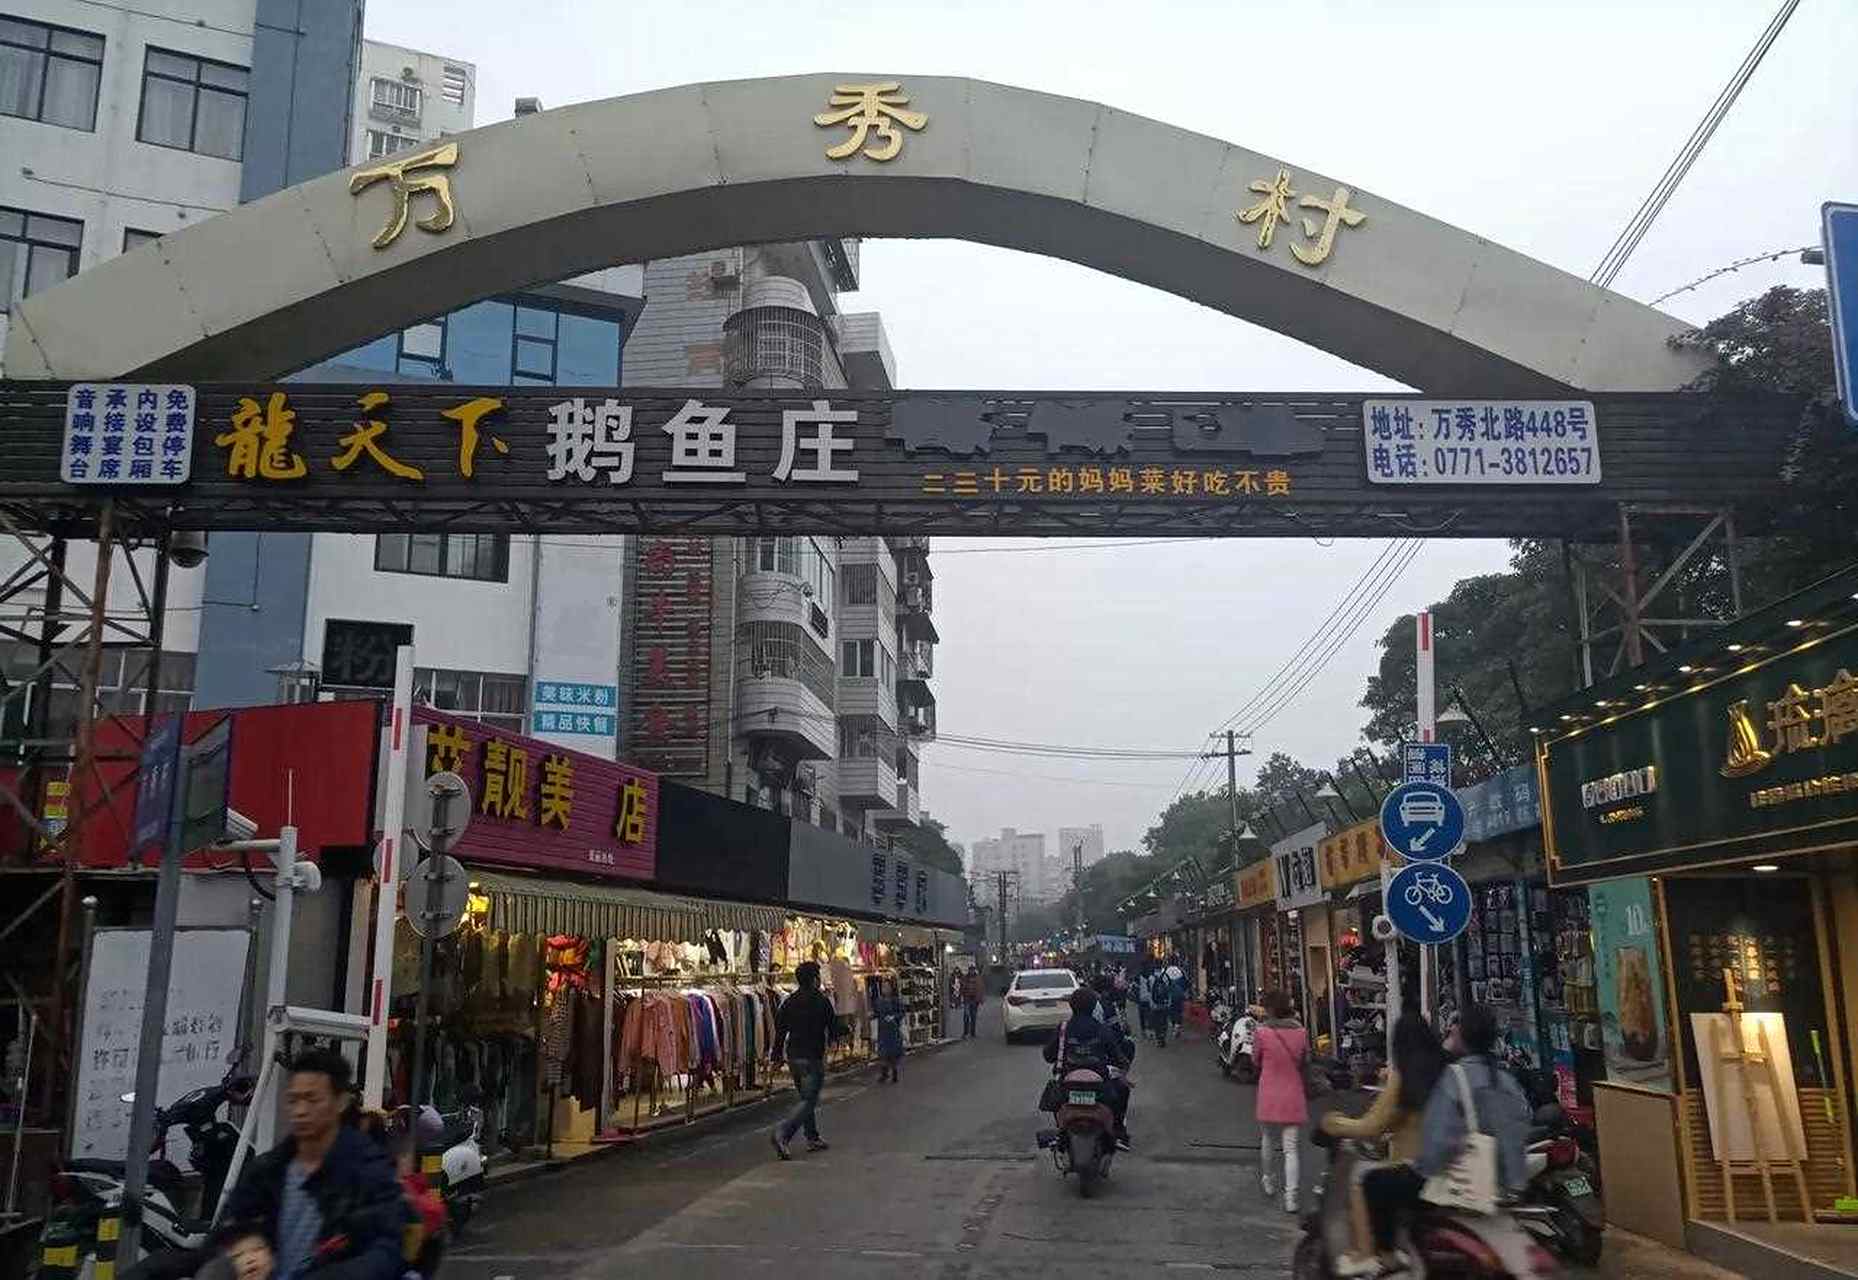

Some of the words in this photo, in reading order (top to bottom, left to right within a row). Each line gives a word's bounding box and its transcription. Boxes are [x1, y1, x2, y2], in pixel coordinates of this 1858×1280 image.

[350, 80, 1368, 267] 万秀村
[69, 388, 97, 479] 音响舞台
[97, 388, 128, 480] 承接宴席
[129, 388, 159, 480] 内设包厢
[160, 388, 190, 480] 免费停车
[216, 391, 509, 479] 龍天下
[546, 399, 859, 484] 鹅鱼庄
